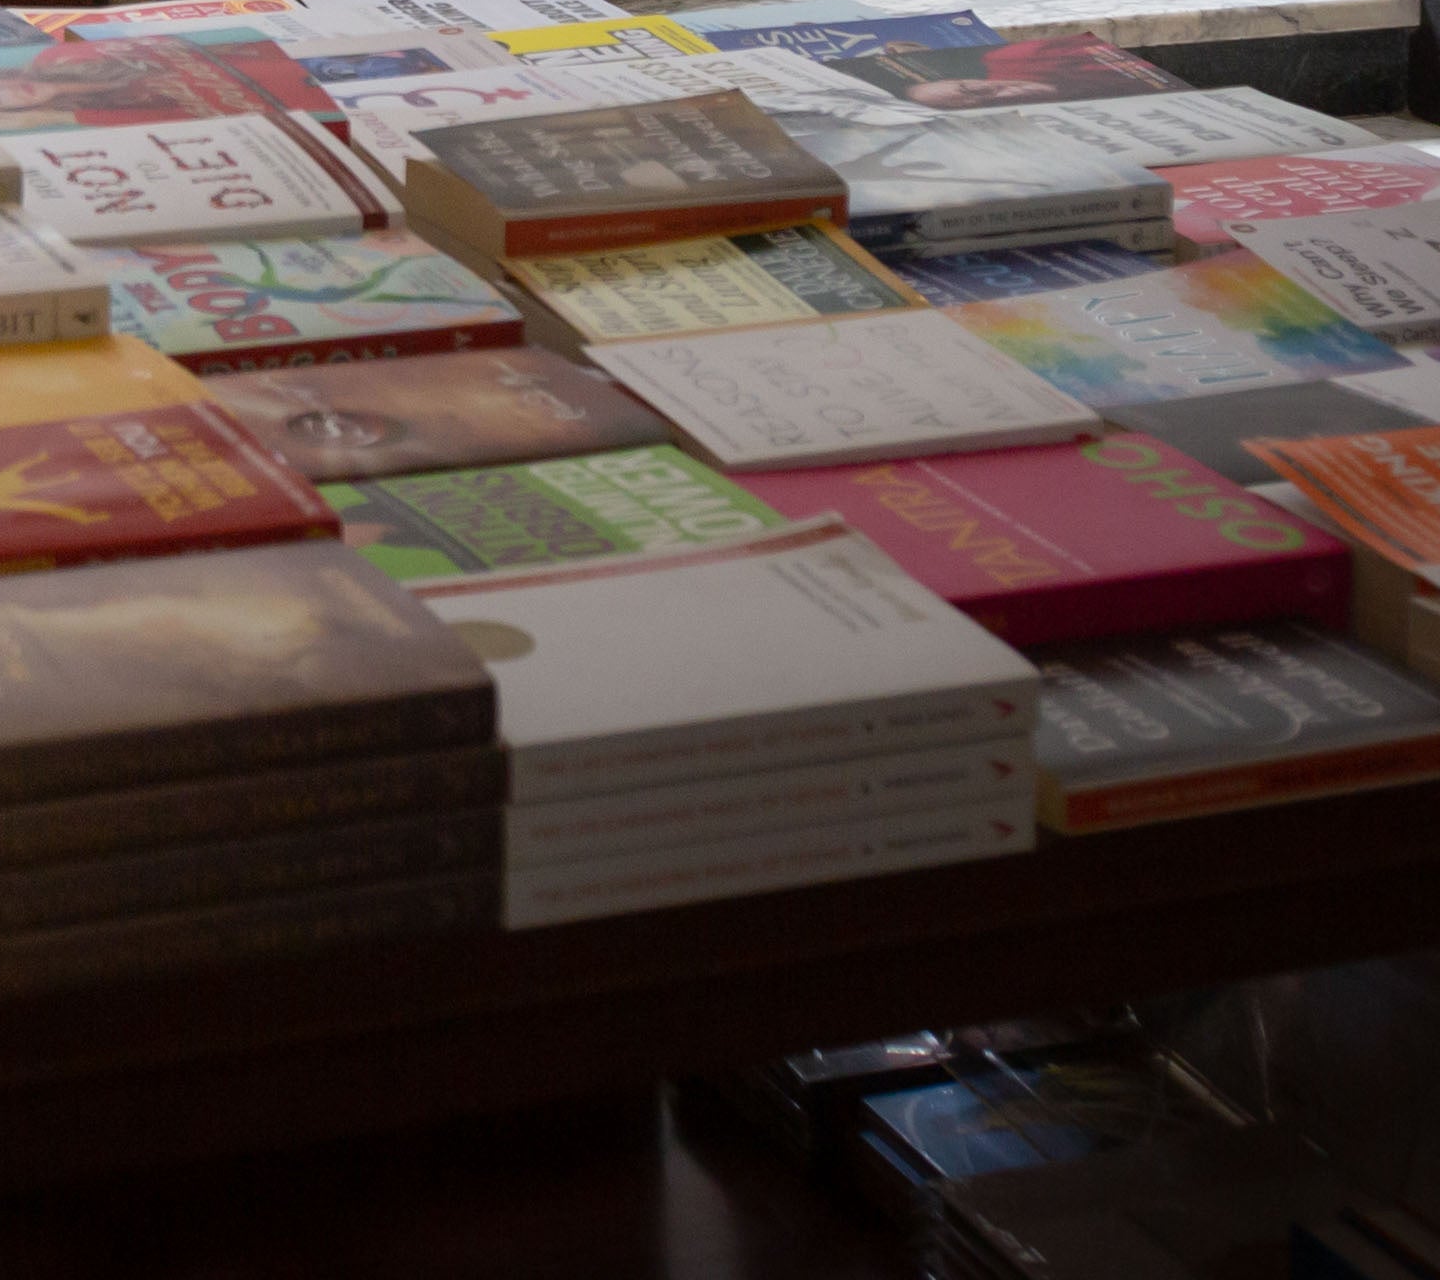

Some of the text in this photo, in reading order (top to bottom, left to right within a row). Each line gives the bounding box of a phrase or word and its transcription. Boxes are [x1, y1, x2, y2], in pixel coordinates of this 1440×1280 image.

[634, 110, 729, 180] Malcolm
[668, 109, 776, 179] Gladwell
[1139, 110, 1235, 141] EMAIL
[148, 131, 274, 211] DIET
[562, 160, 610, 190] Dog
[1282, 239, 1395, 319] Why Can't
[1314, 239, 1426, 315] We Sleep?
[1078, 290, 1275, 385] HAPPY
[647, 346, 806, 447] REASONS
[819, 405, 881, 437] TO
[851, 370, 943, 429] ALIVE
[615, 448, 761, 543] OWER
[851, 463, 1061, 590] TANTRA
[1079, 436, 1308, 553] OSHO
